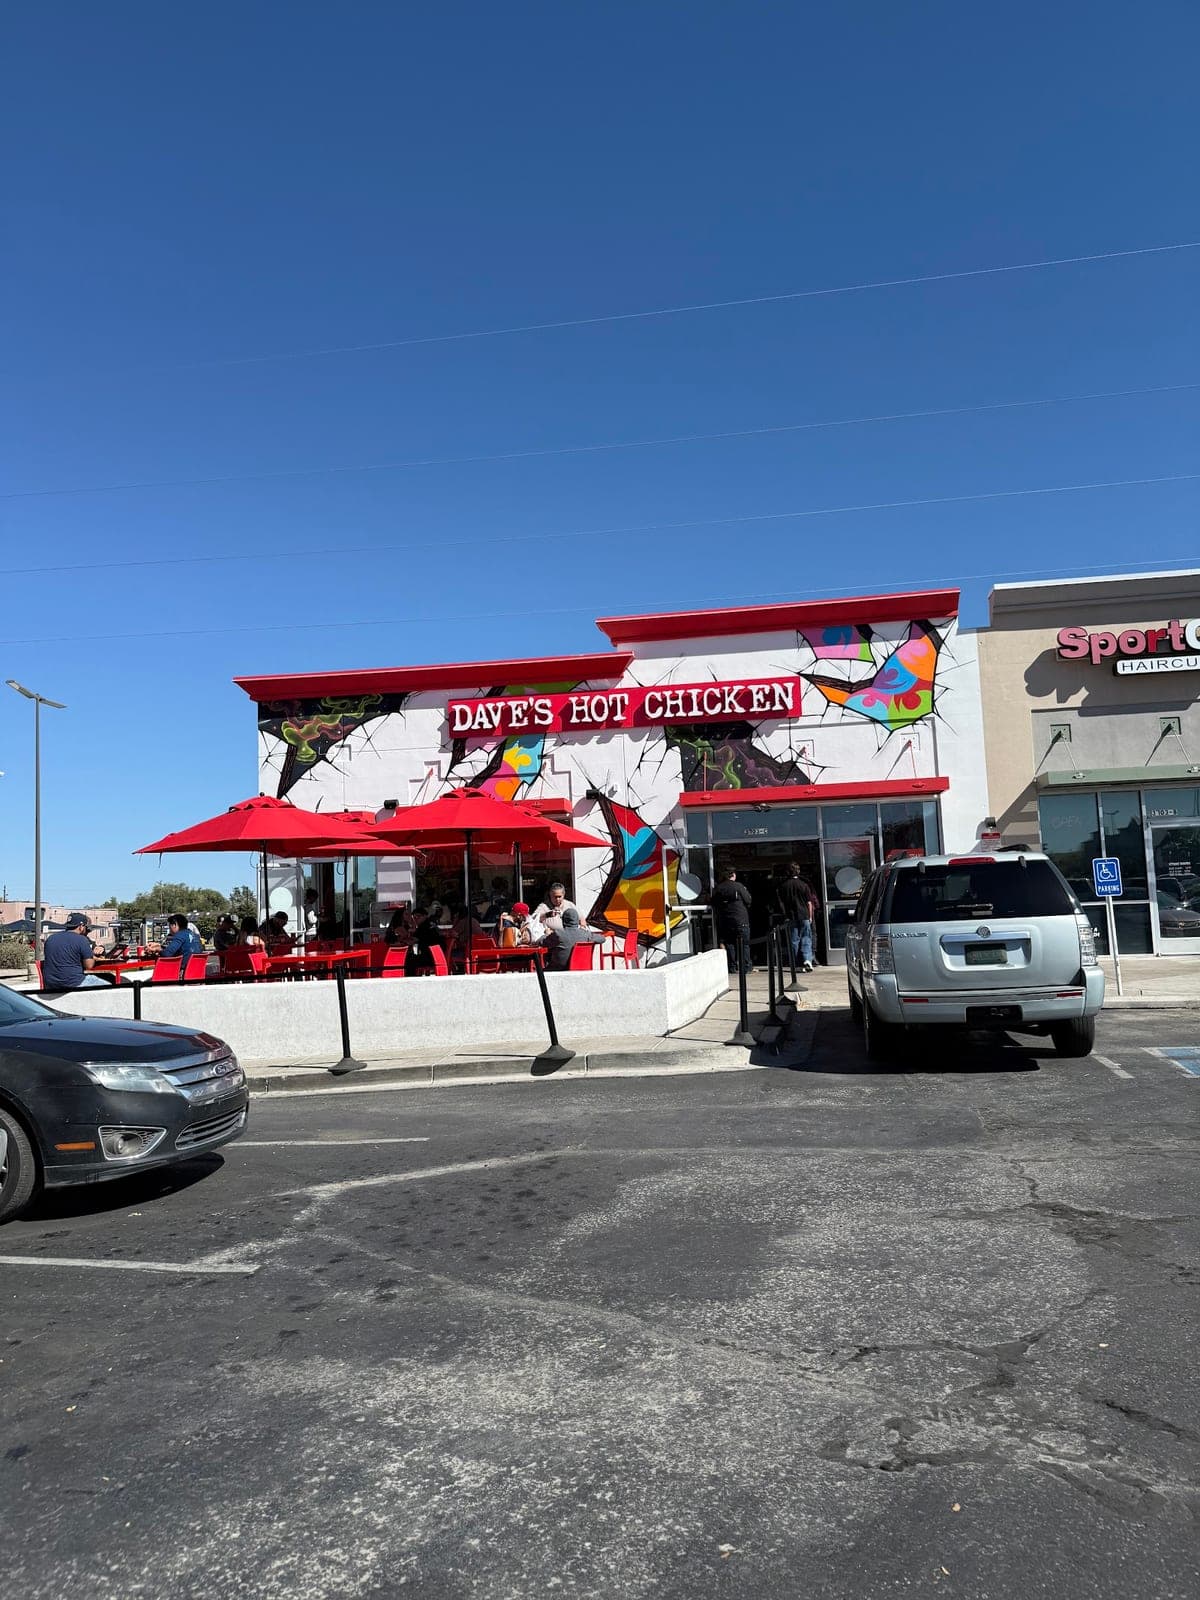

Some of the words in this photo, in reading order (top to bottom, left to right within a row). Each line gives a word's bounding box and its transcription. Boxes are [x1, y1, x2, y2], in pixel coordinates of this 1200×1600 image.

[452, 697, 553, 731] DAVE'S
[569, 693, 629, 724] HOT
[644, 682, 796, 719] CHICKEN
